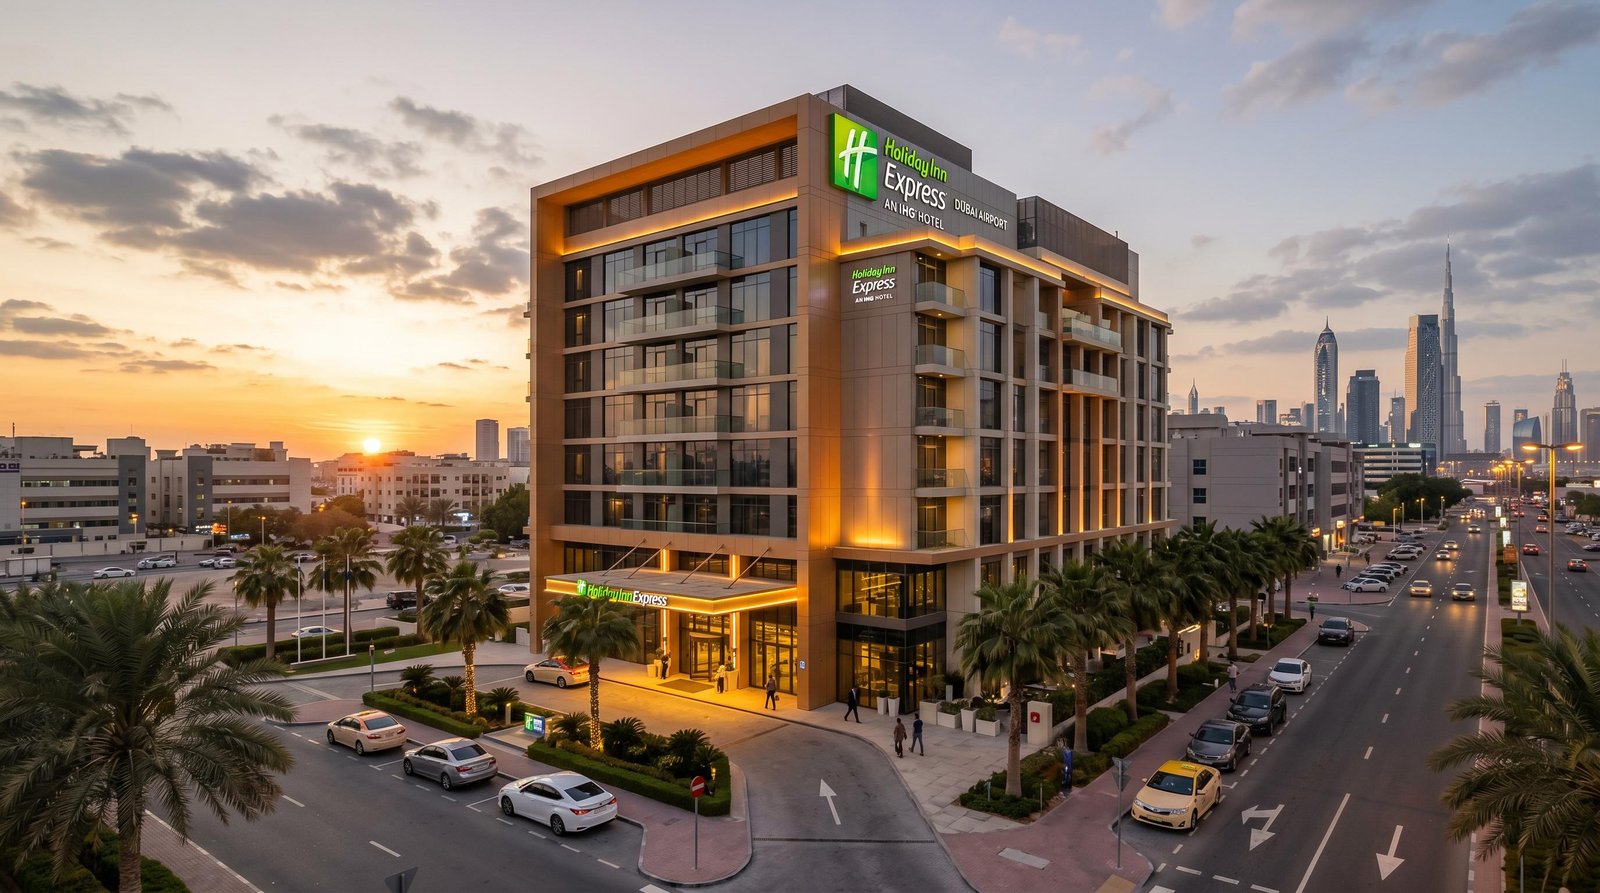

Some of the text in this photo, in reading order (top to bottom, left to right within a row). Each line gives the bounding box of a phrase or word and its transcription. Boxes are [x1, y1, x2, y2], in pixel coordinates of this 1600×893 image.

[885, 137, 947, 183] Holiday Inn
[885, 162, 946, 210] Express
[884, 198, 945, 230] AN IHG HOTEL
[954, 198, 1008, 231] DUBAI AIRPORT
[852, 264, 896, 279] Holiday Inn
[852, 278, 896, 295] Express
[875, 293, 893, 301] HOTEL
[633, 590, 668, 607] Express
